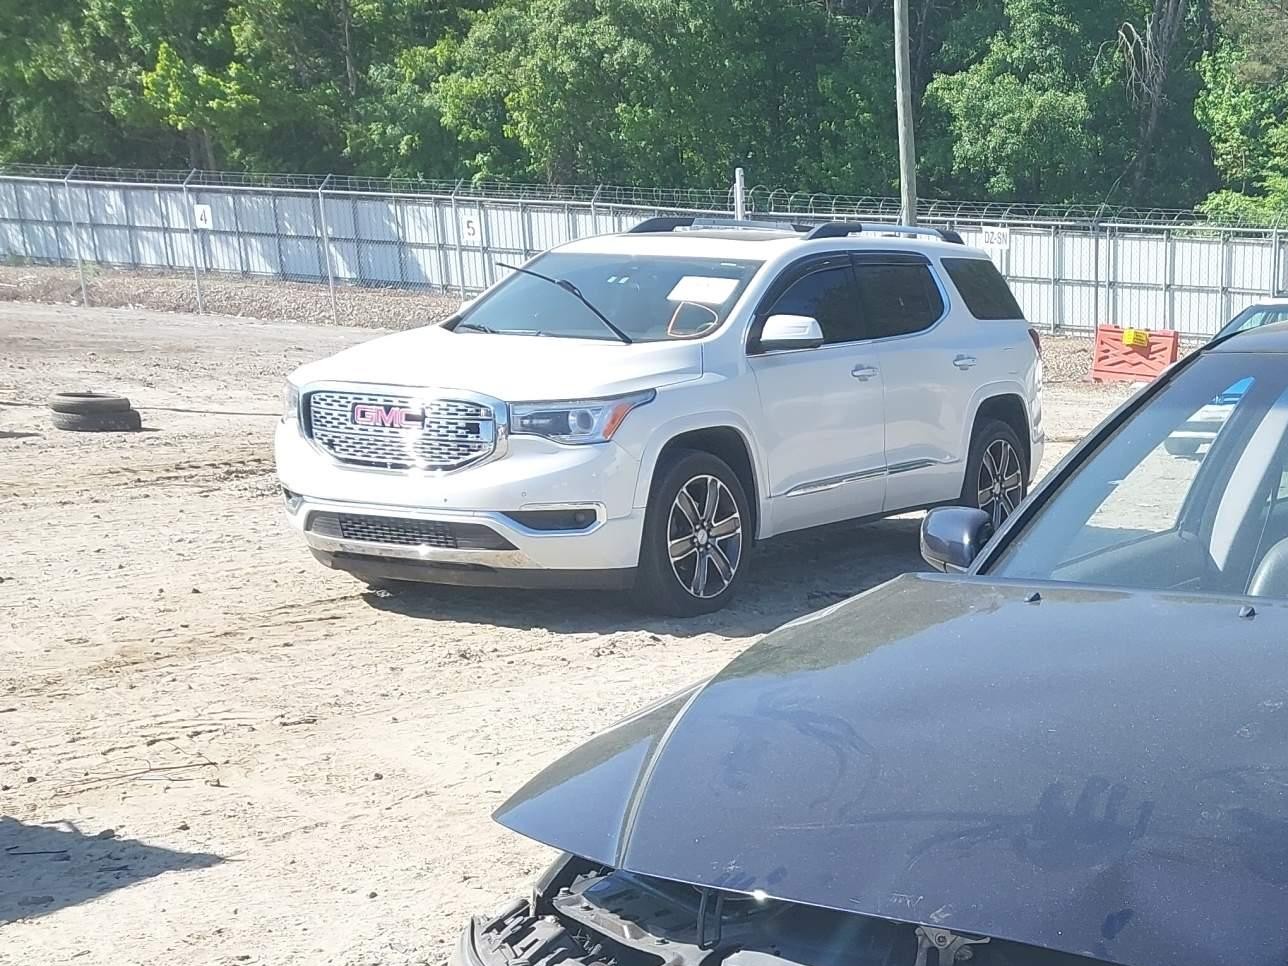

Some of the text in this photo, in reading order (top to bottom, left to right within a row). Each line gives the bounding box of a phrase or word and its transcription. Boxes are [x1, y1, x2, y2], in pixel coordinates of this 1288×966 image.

[199, 207, 208, 225] 4
[466, 219, 476, 237] 5
[355, 404, 424, 428] GMC
